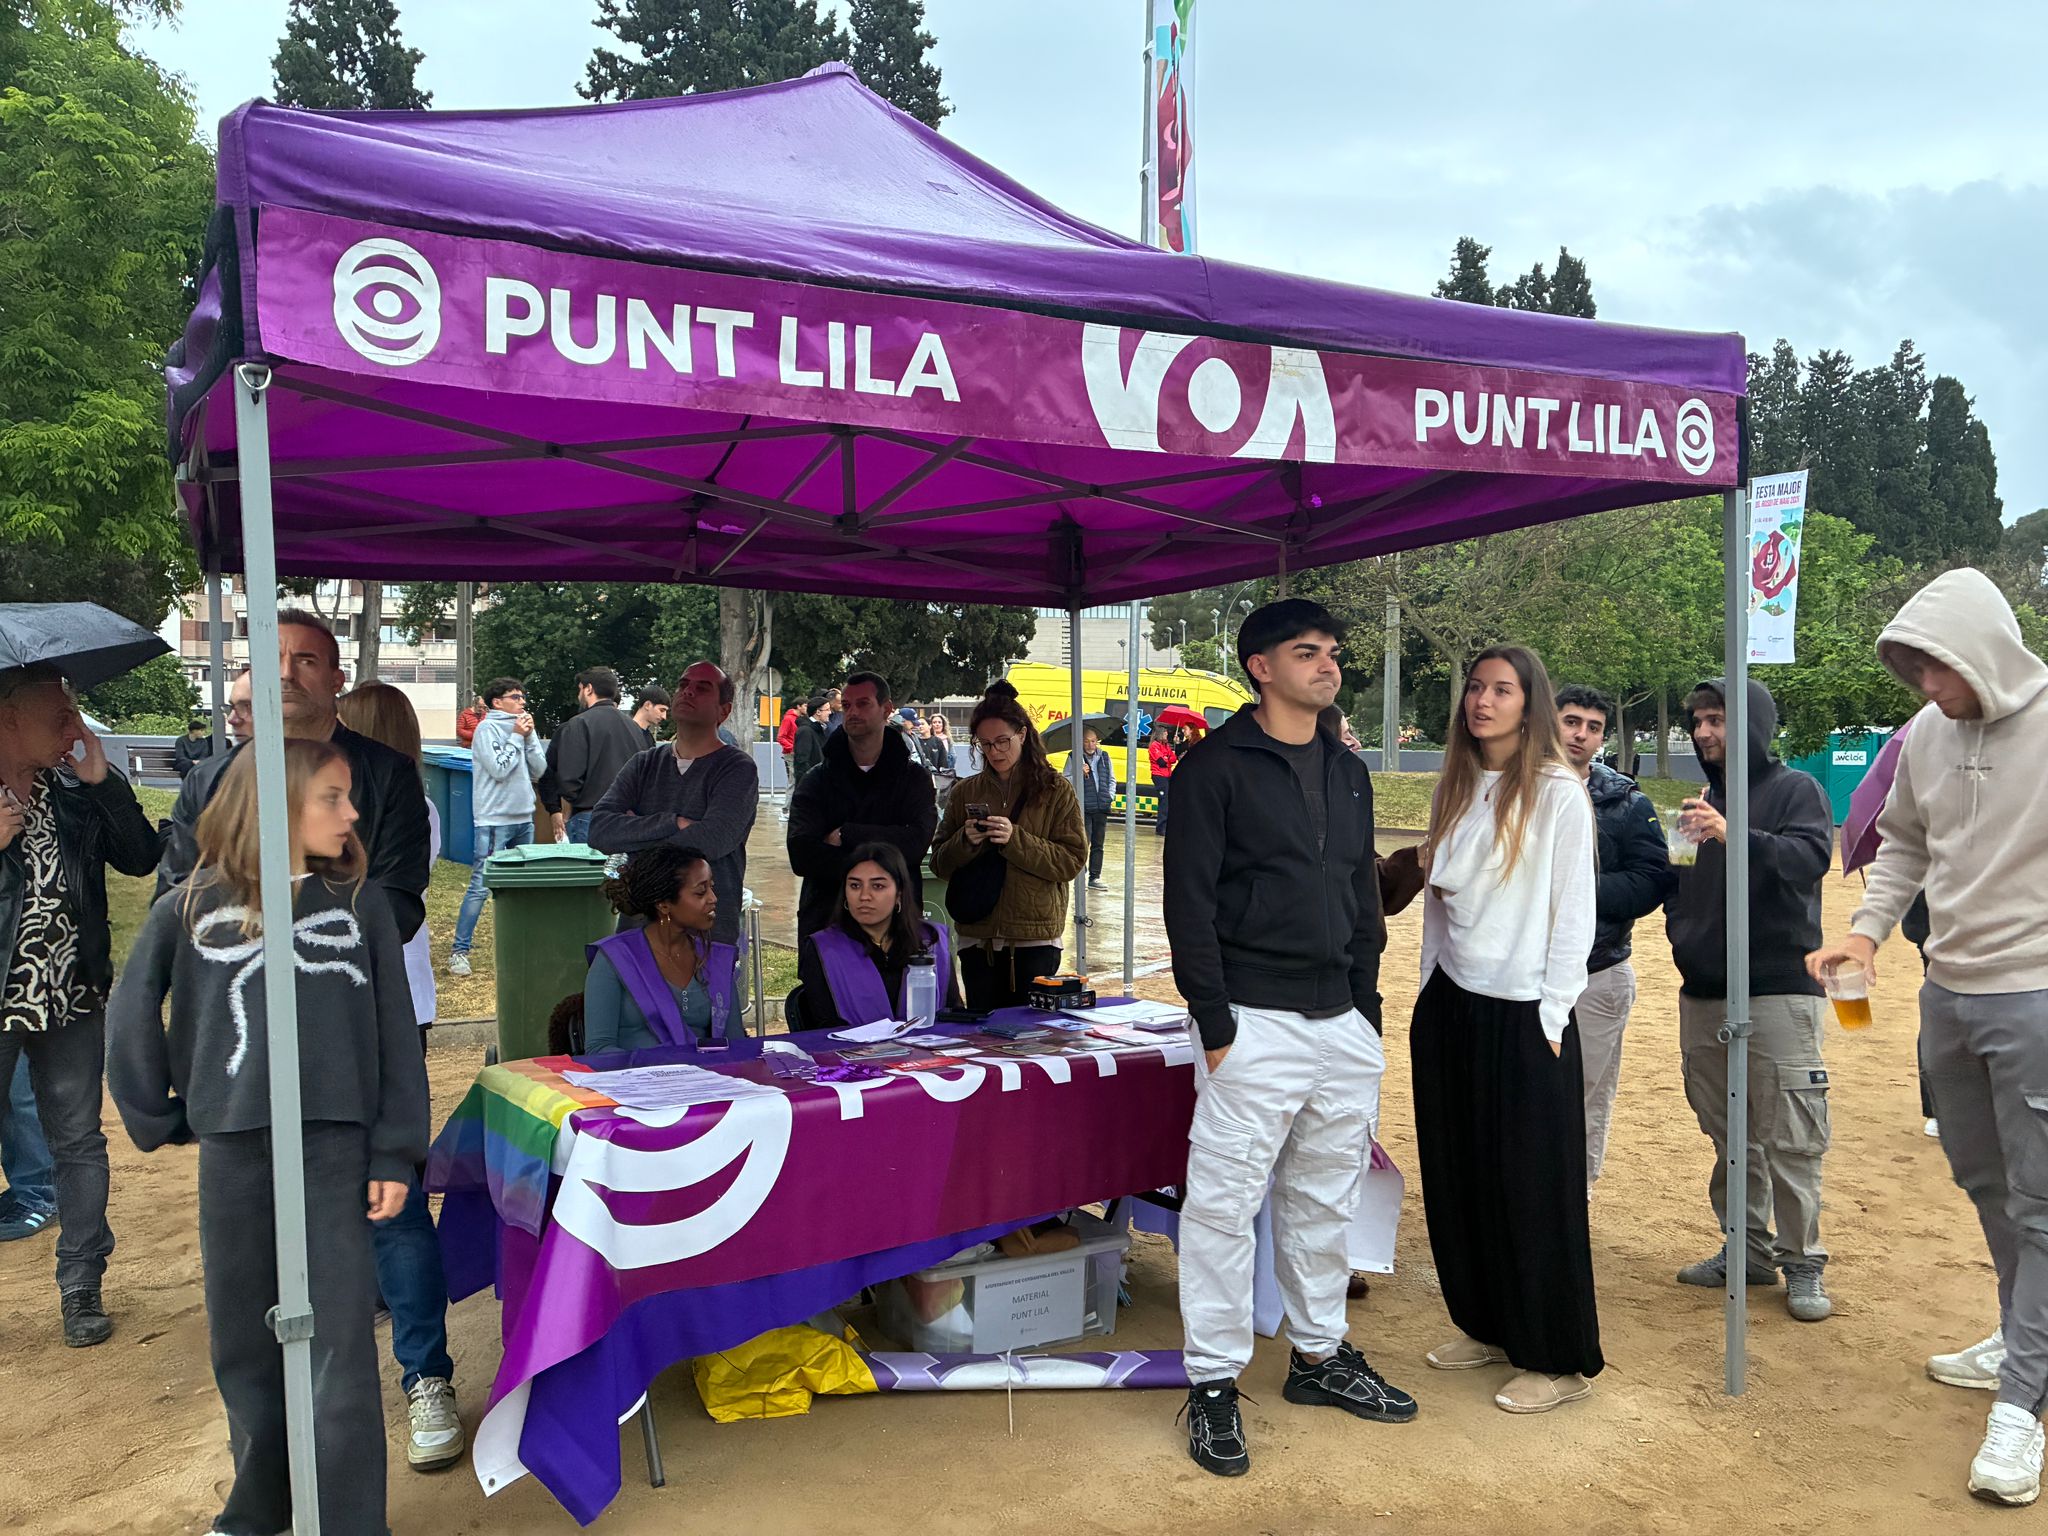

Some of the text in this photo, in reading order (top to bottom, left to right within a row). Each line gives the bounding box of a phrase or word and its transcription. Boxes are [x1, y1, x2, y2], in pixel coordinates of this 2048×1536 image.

[486, 277, 960, 402] PUNT LILA
[1415, 388, 1666, 457] PUNT LILA
[1756, 480, 1802, 499] FESTA MAJOR
[1116, 685, 1187, 699] AULÀNCIA
[1012, 1290, 1049, 1304] MATERIAL
[1011, 1306, 1049, 1320] PUNT LILA
